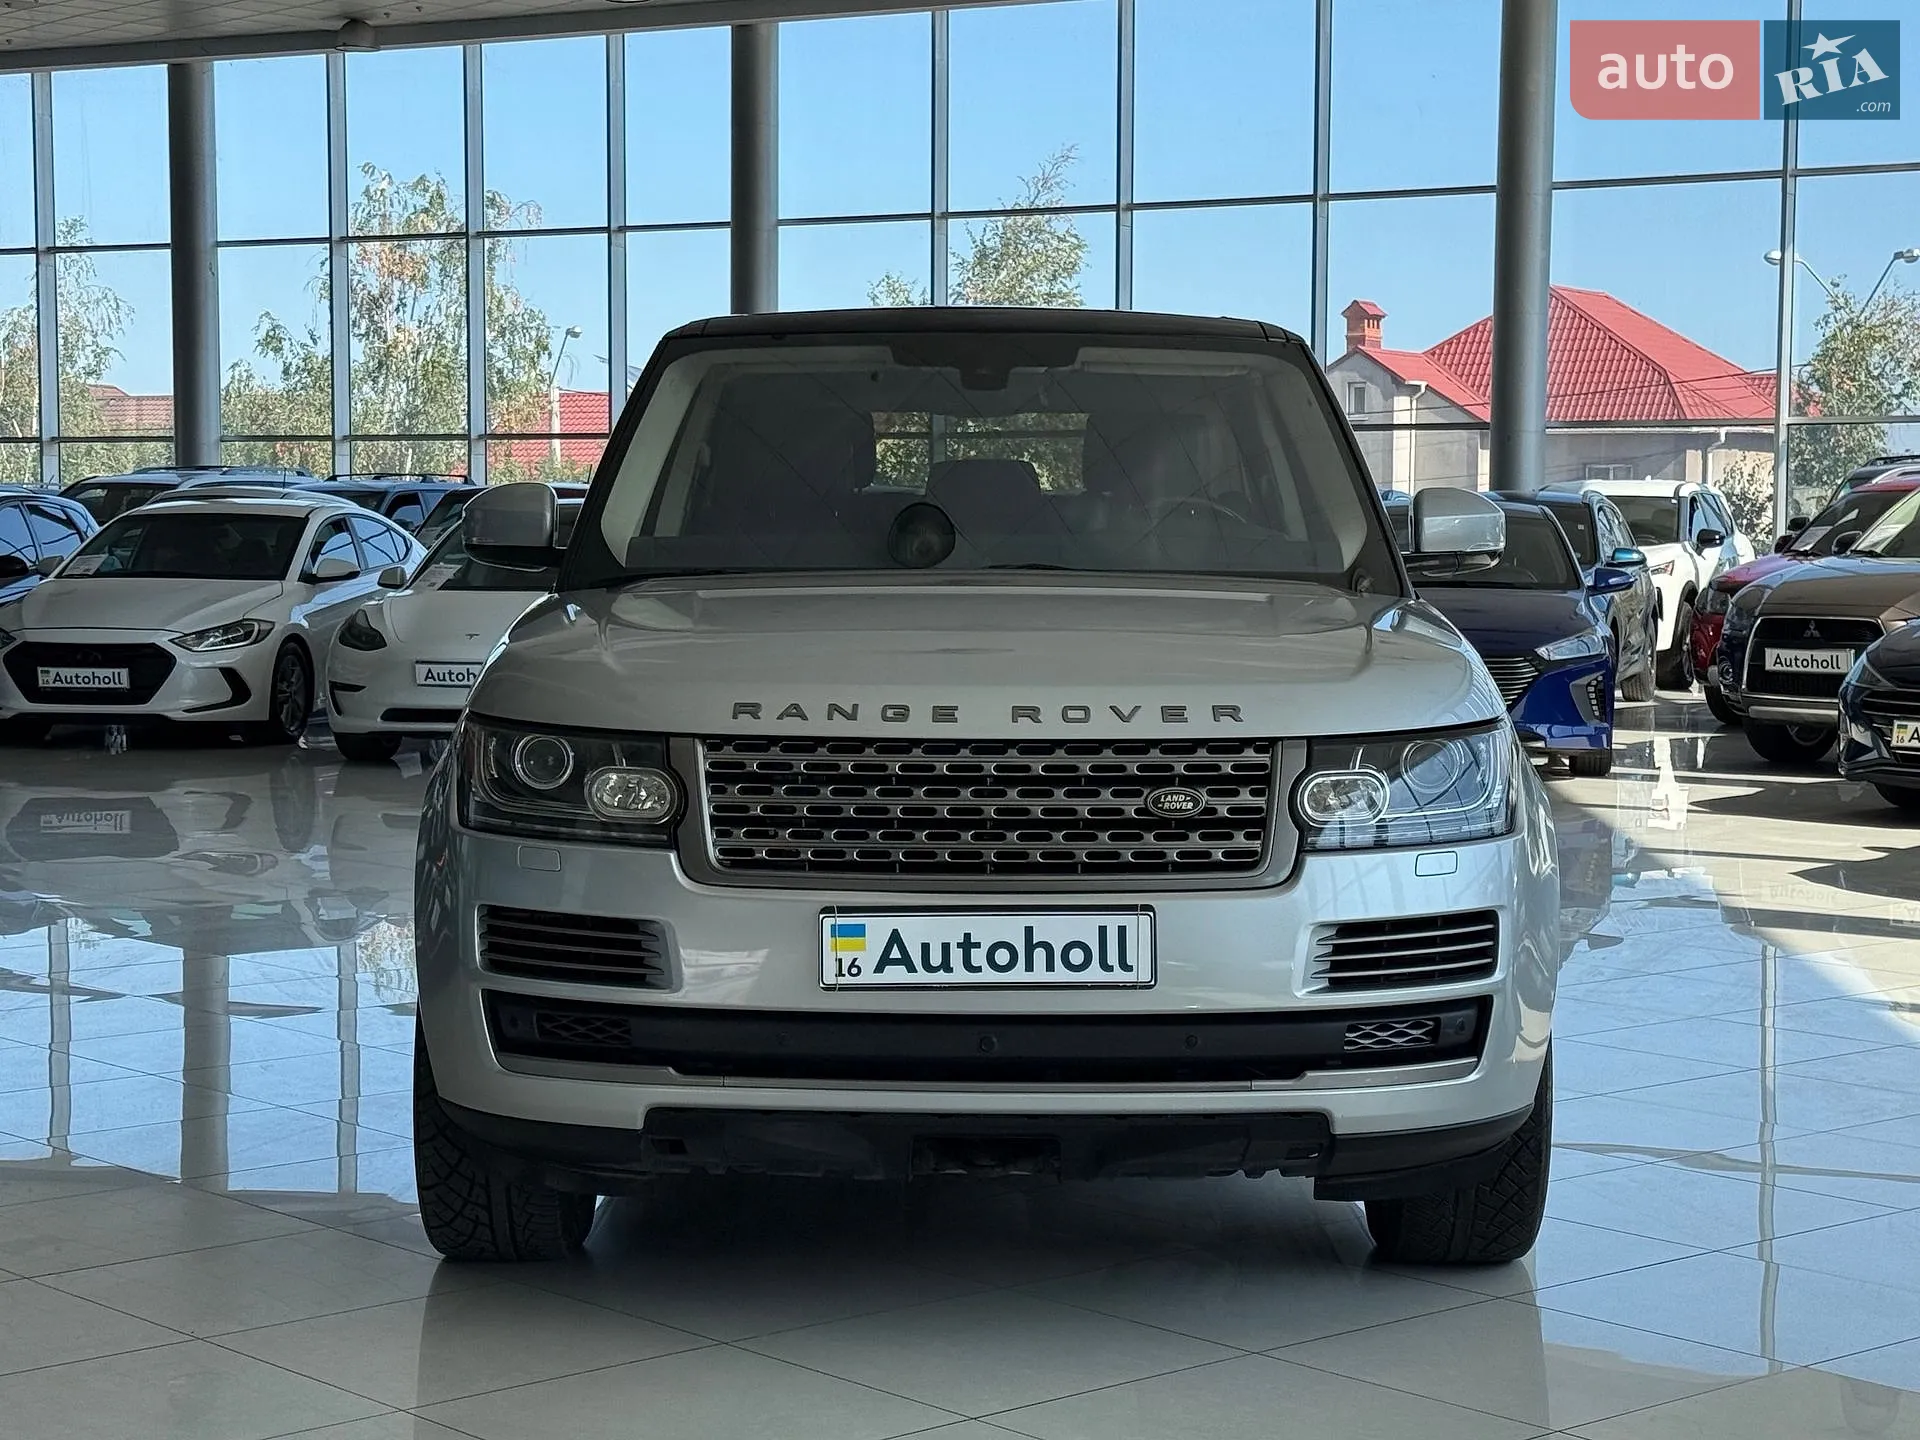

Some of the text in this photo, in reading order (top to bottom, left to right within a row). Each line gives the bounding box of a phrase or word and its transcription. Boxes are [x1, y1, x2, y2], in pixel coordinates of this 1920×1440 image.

[1772, 653, 1841, 670] Autoholl
[52, 671, 123, 685] Autoholl
[424, 667, 477, 682] Autoh
[731, 702, 1244, 724] RANGE ROVER
[1896, 734, 1905, 744] 16
[835, 925, 1134, 977] 16 Autoholl
